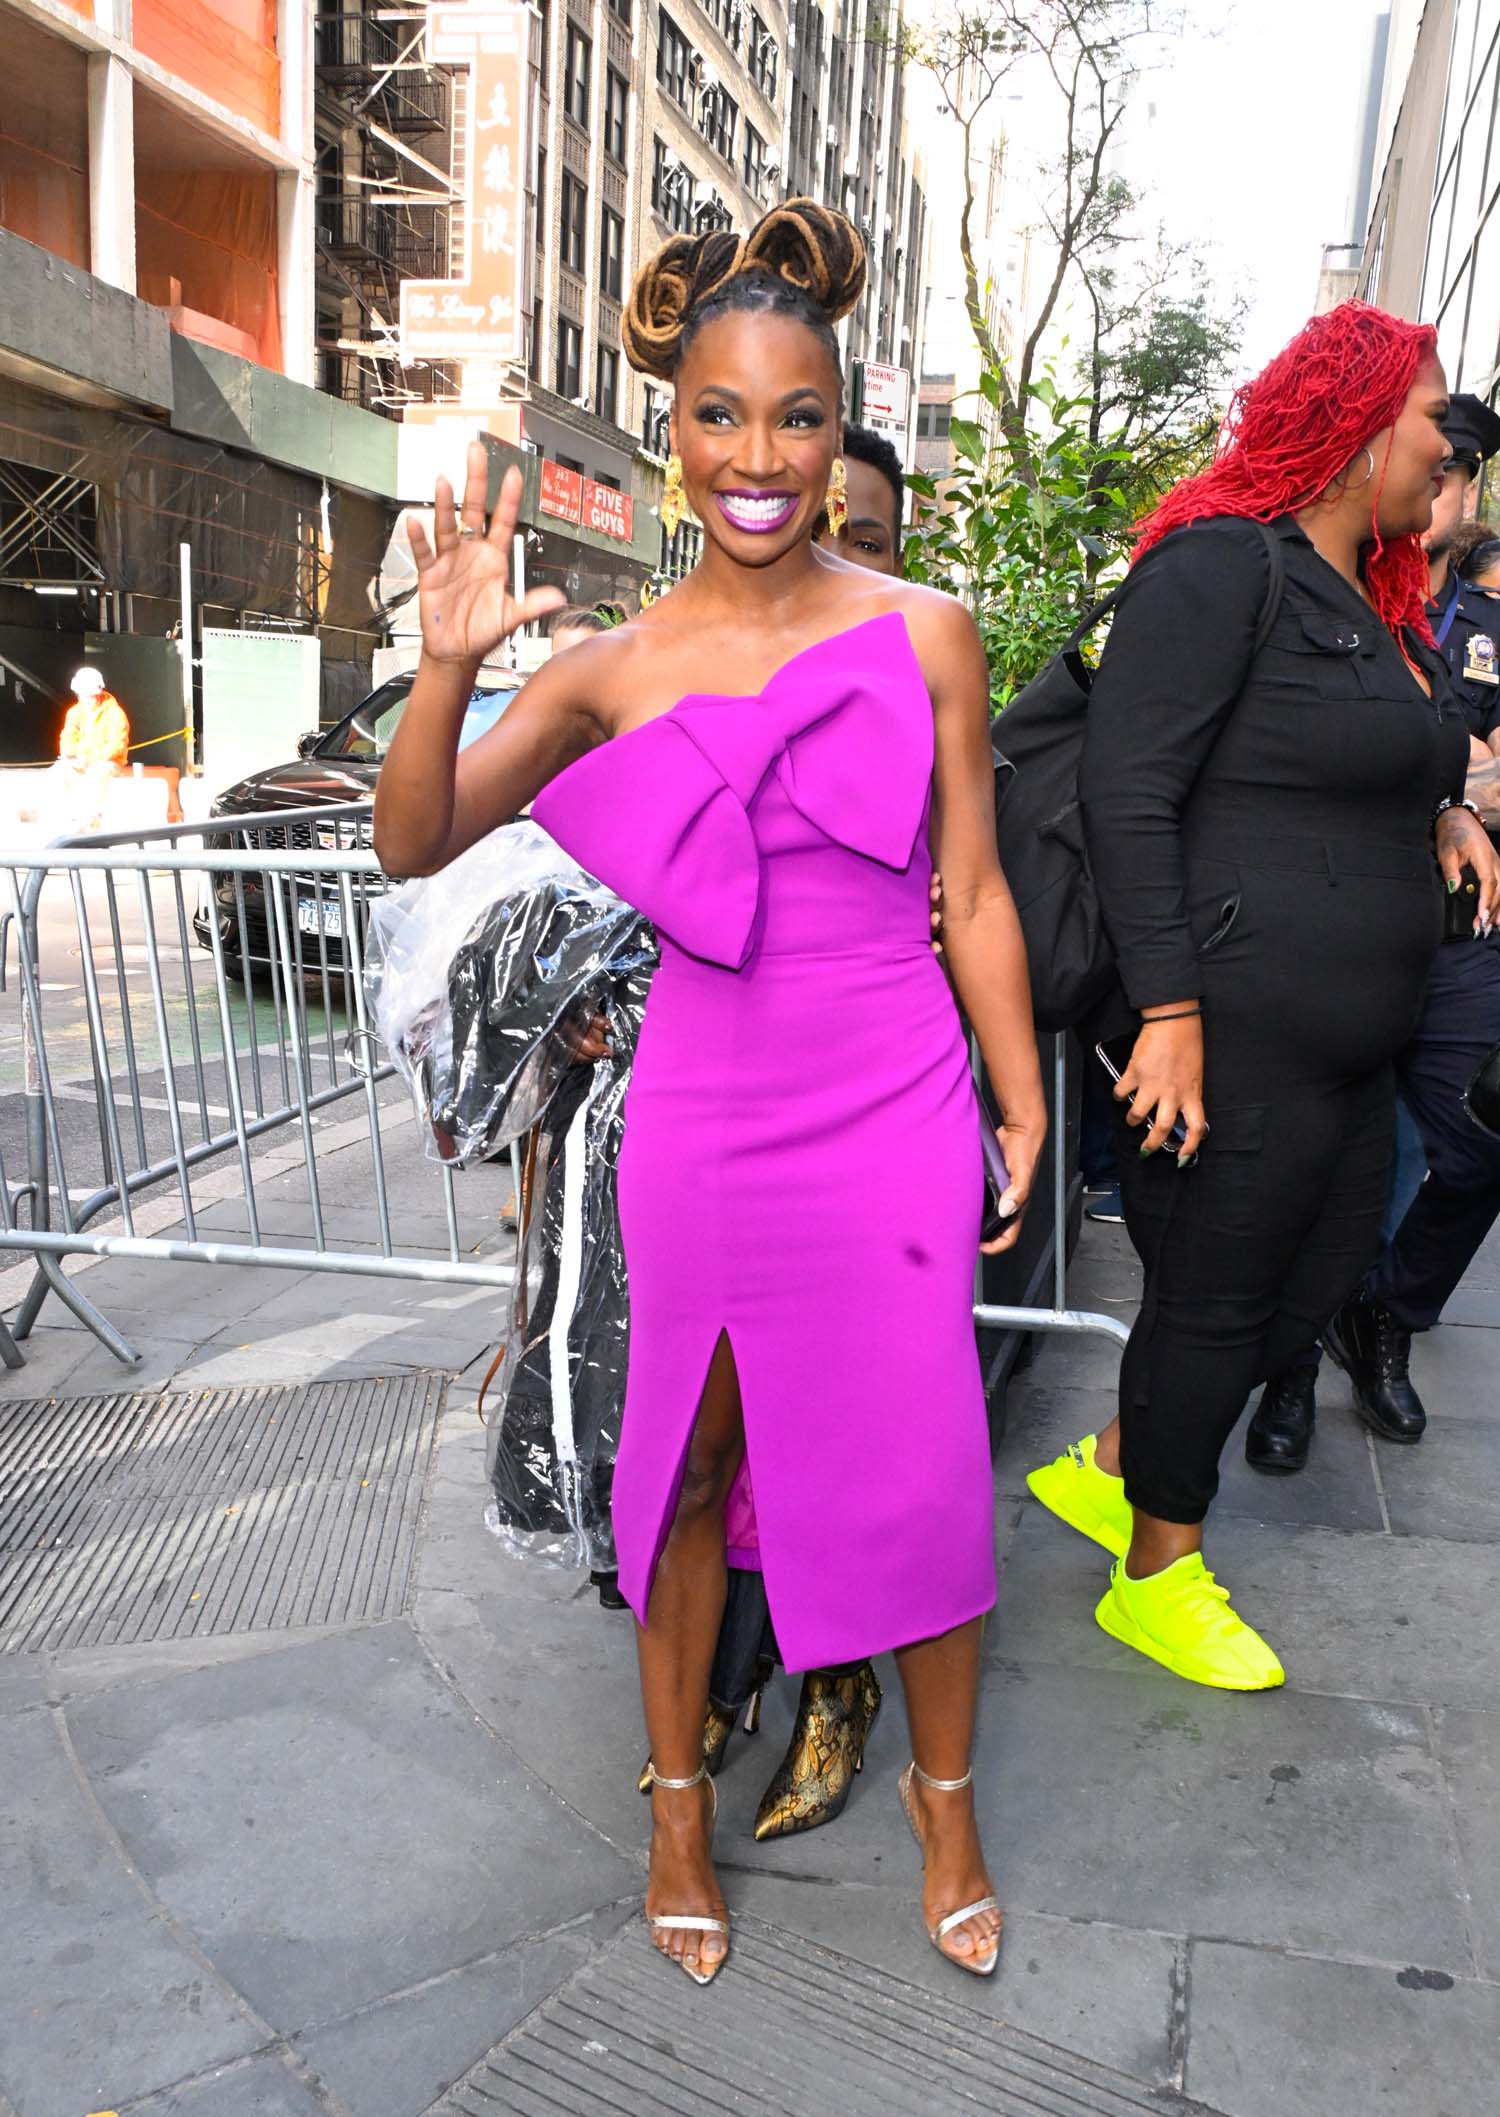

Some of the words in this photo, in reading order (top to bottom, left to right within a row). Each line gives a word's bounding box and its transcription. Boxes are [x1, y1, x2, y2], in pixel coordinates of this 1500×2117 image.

[863, 380, 883, 392] ytime
[867, 367, 896, 383] PARKING
[595, 486, 623, 514] FIVE
[591, 506, 625, 536] GUYS
